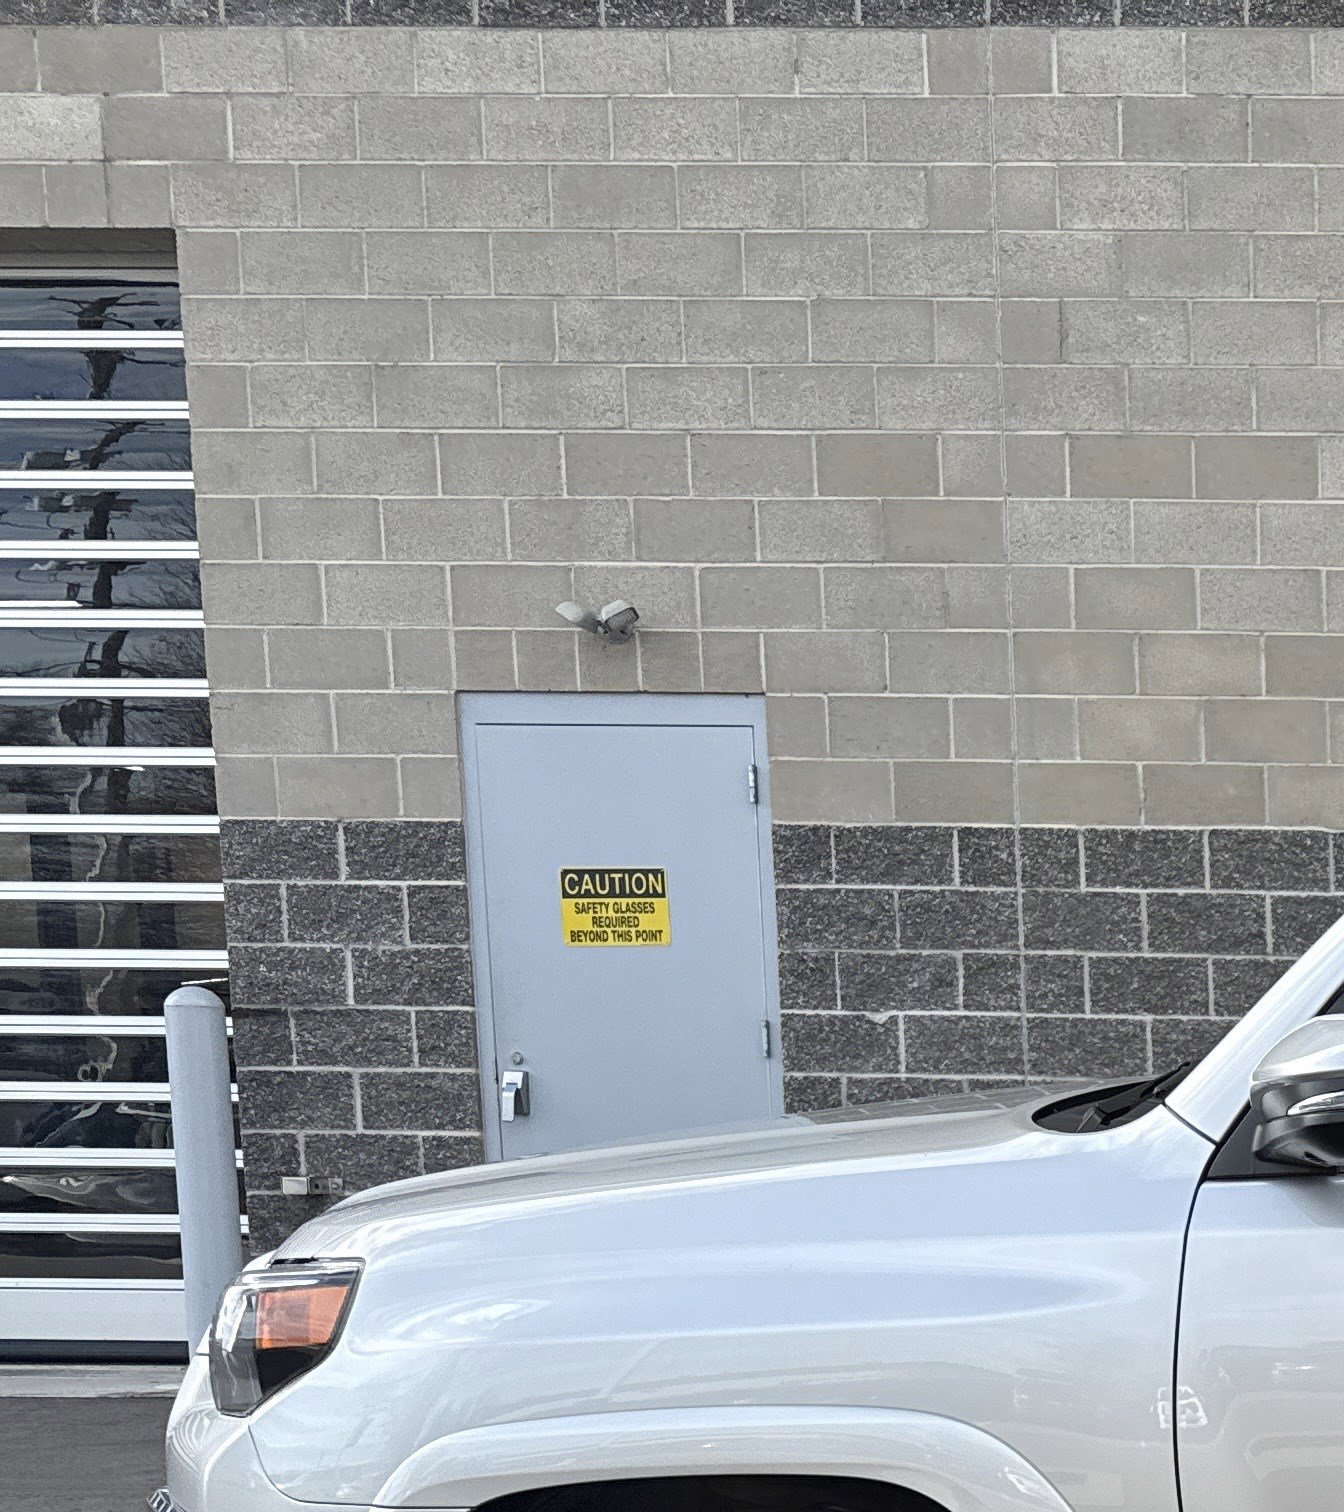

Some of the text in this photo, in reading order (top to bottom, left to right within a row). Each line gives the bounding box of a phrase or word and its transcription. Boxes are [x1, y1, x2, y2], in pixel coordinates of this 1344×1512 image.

[564, 872, 663, 895] CAUTION
[574, 901, 656, 914] SAFETY GLASSES
[591, 915, 640, 928] REQUIRED
[569, 929, 664, 942] BEYOND THIS POINT
